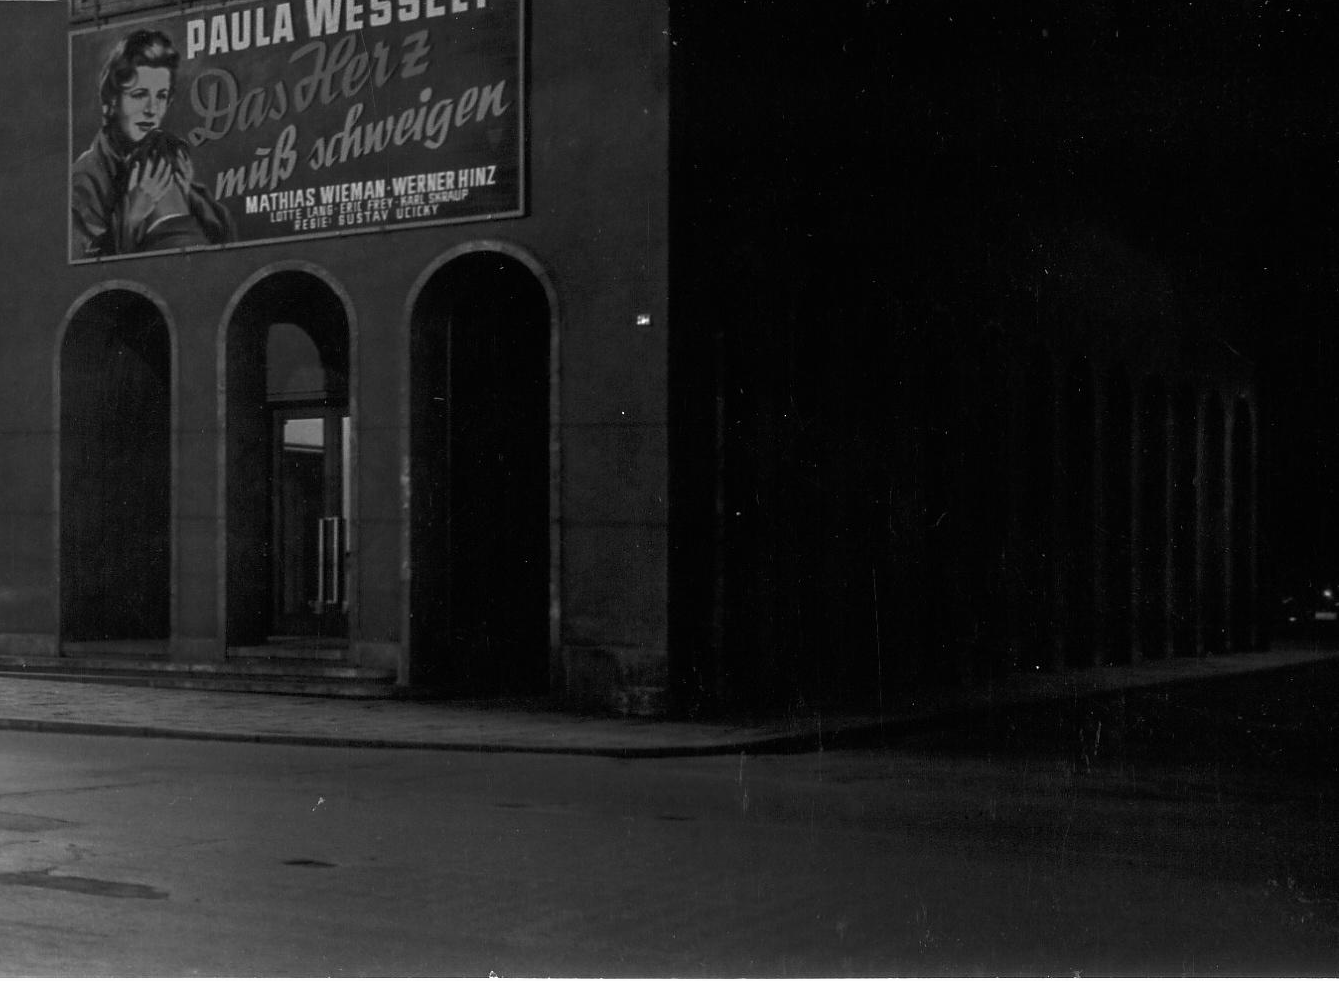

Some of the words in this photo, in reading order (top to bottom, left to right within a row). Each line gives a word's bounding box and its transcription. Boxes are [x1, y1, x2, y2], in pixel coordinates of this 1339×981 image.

[186, 3, 295, 59] PAULA
[188, 68, 290, 147] Das
[289, 29, 434, 110] Herz
[309, 78, 511, 171] schweigen
[245, 187, 316, 214] MATHIAS
[392, 172, 455, 197] WERNER
[458, 165, 496, 188] HINZ
[270, 208, 302, 223] LOTTE
[338, 211, 388, 226] GUSTAV
